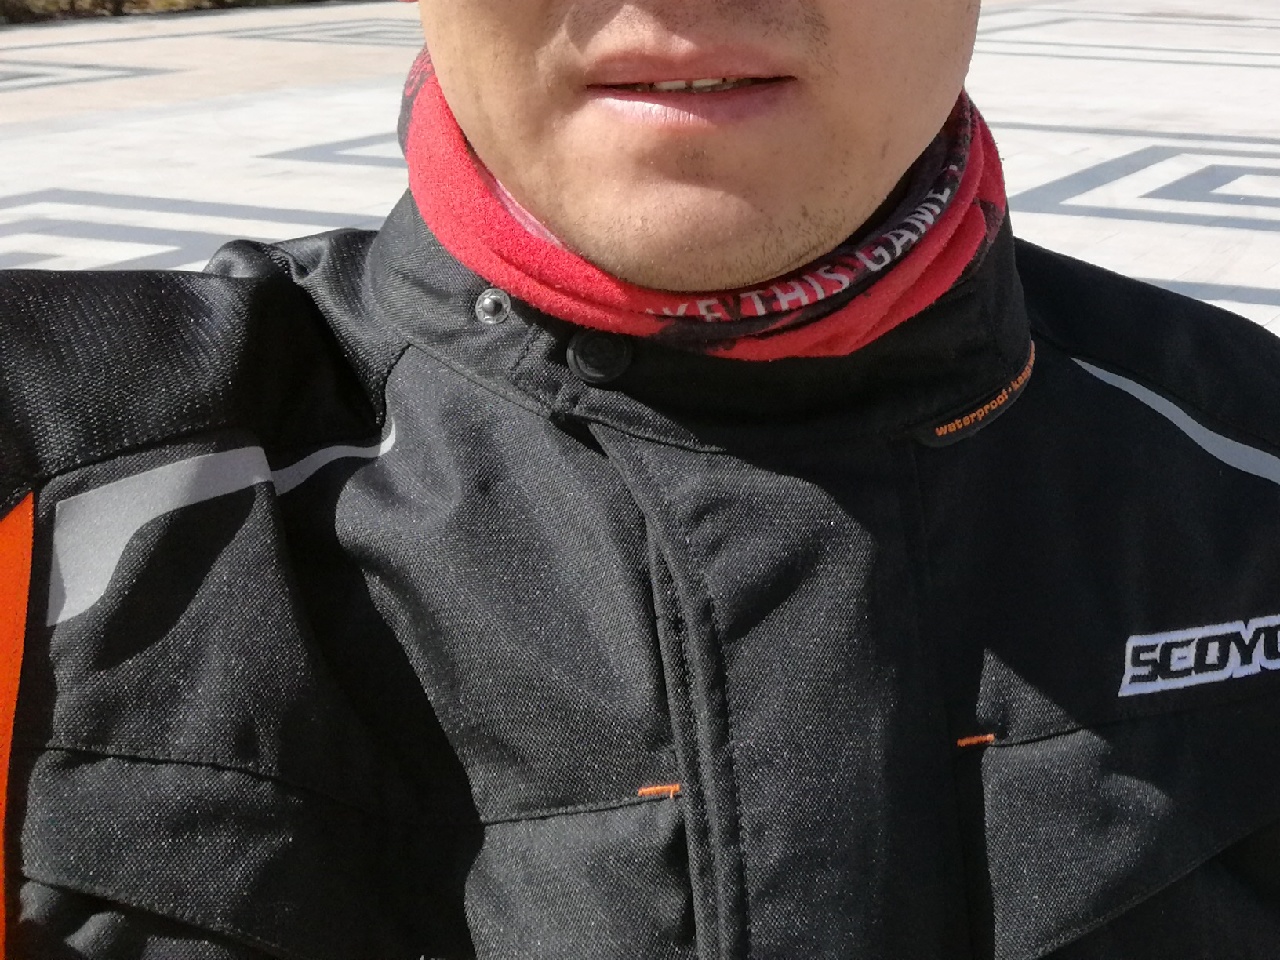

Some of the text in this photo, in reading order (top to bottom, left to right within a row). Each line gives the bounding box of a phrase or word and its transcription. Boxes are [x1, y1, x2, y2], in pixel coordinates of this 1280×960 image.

[740, 264, 851, 317] THIS
[856, 188, 952, 272] GAME
[935, 388, 1009, 437] waterproof
